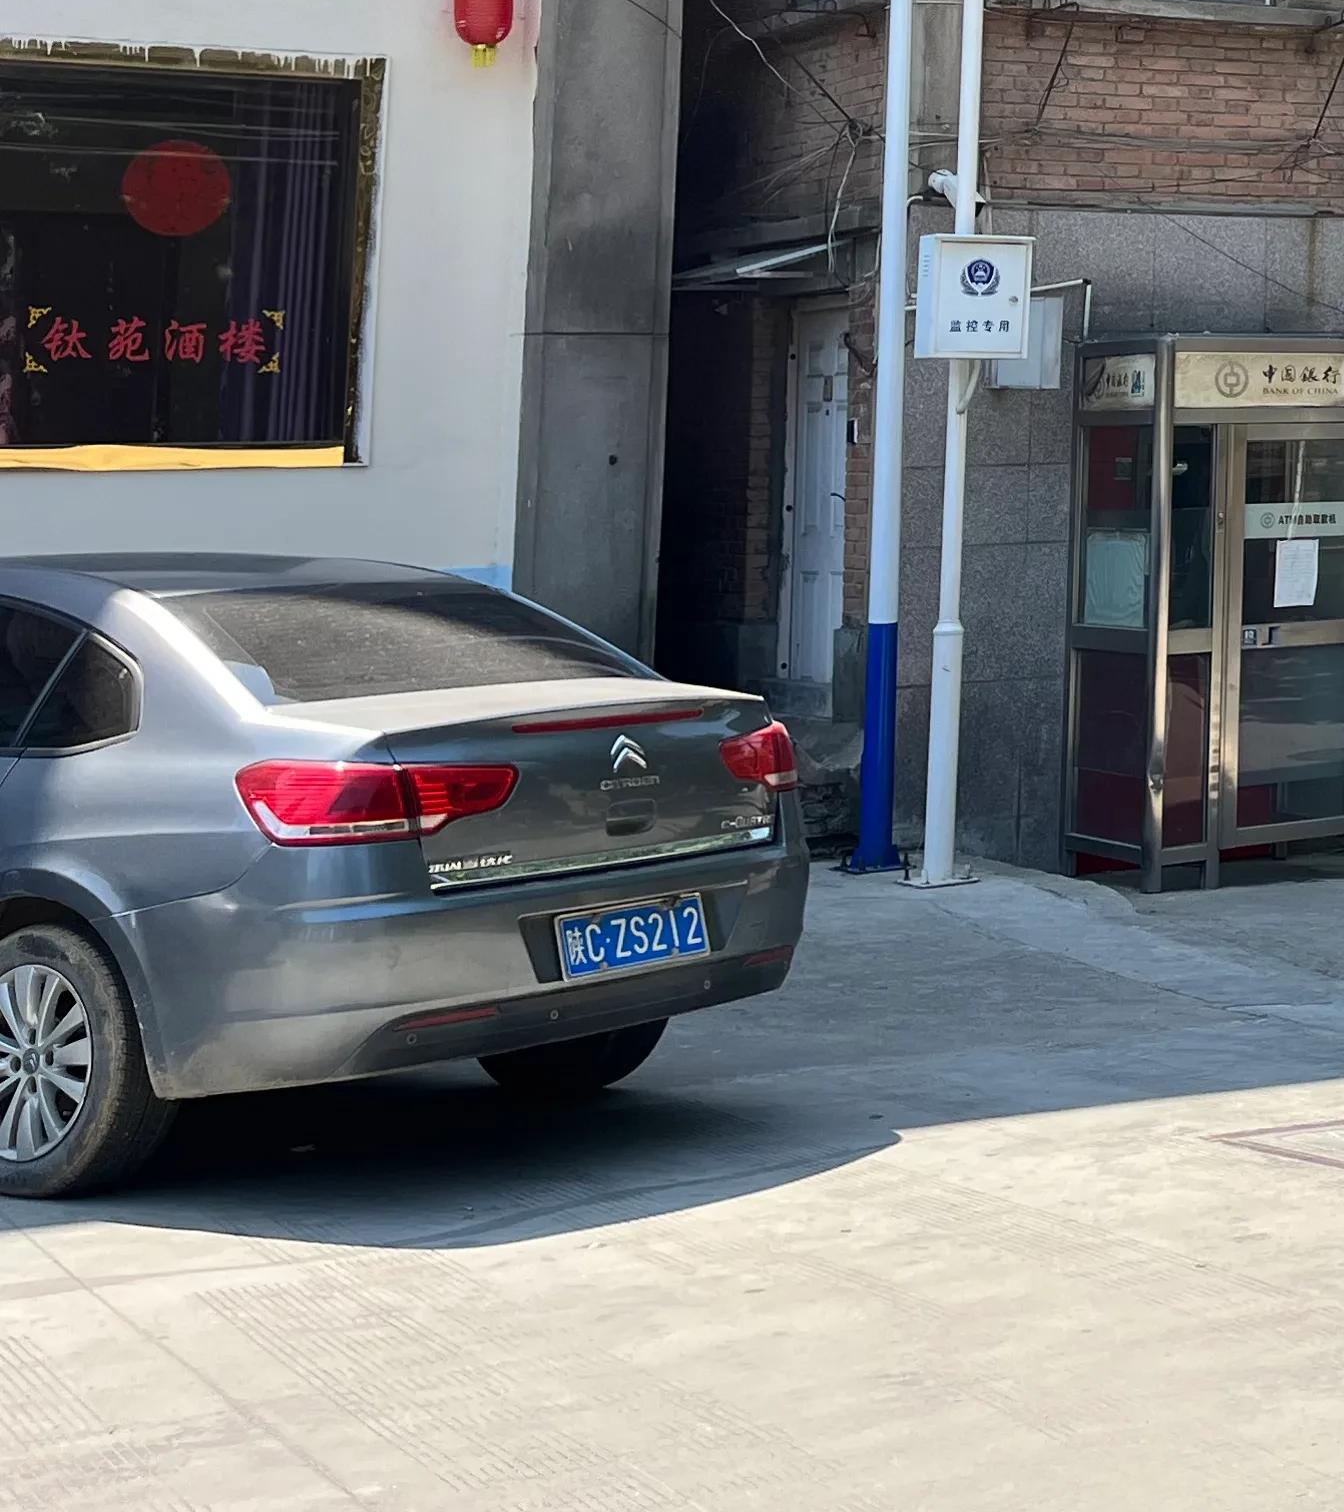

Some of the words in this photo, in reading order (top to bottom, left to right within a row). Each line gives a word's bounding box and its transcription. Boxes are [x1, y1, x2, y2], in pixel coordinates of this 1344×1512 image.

[949, 319, 1010, 333] 监控专用
[41, 315, 269, 365] 钛苑酒楼
[1306, 387, 1339, 395] CHINA
